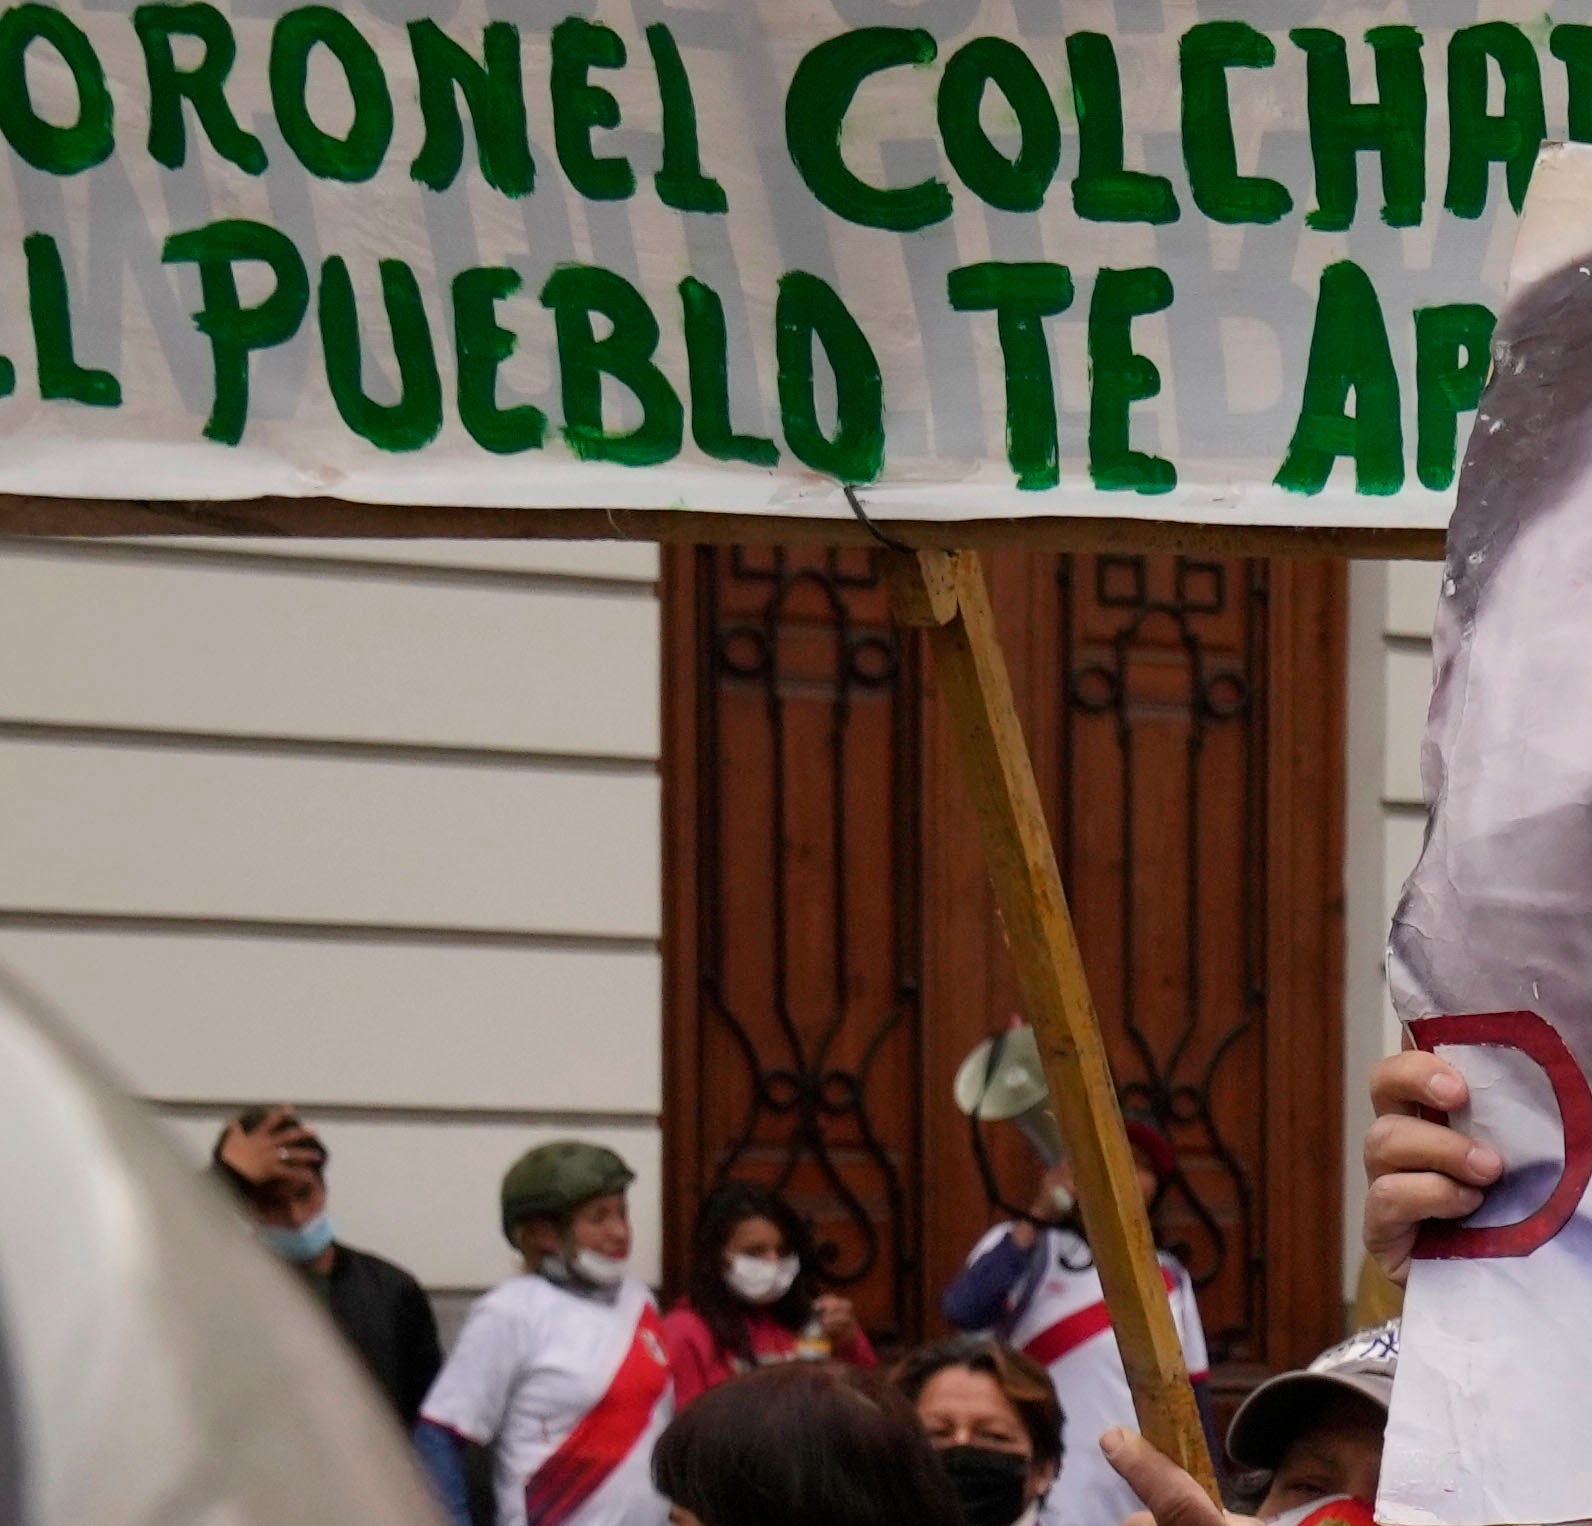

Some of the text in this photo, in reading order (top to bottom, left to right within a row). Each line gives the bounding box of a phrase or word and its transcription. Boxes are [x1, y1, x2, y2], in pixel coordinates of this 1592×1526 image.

[0, 2, 728, 213] ORONEL
[0, 232, 122, 406] L
[162, 220, 886, 486] PUEBLO
[947, 262, 1177, 495] TE
